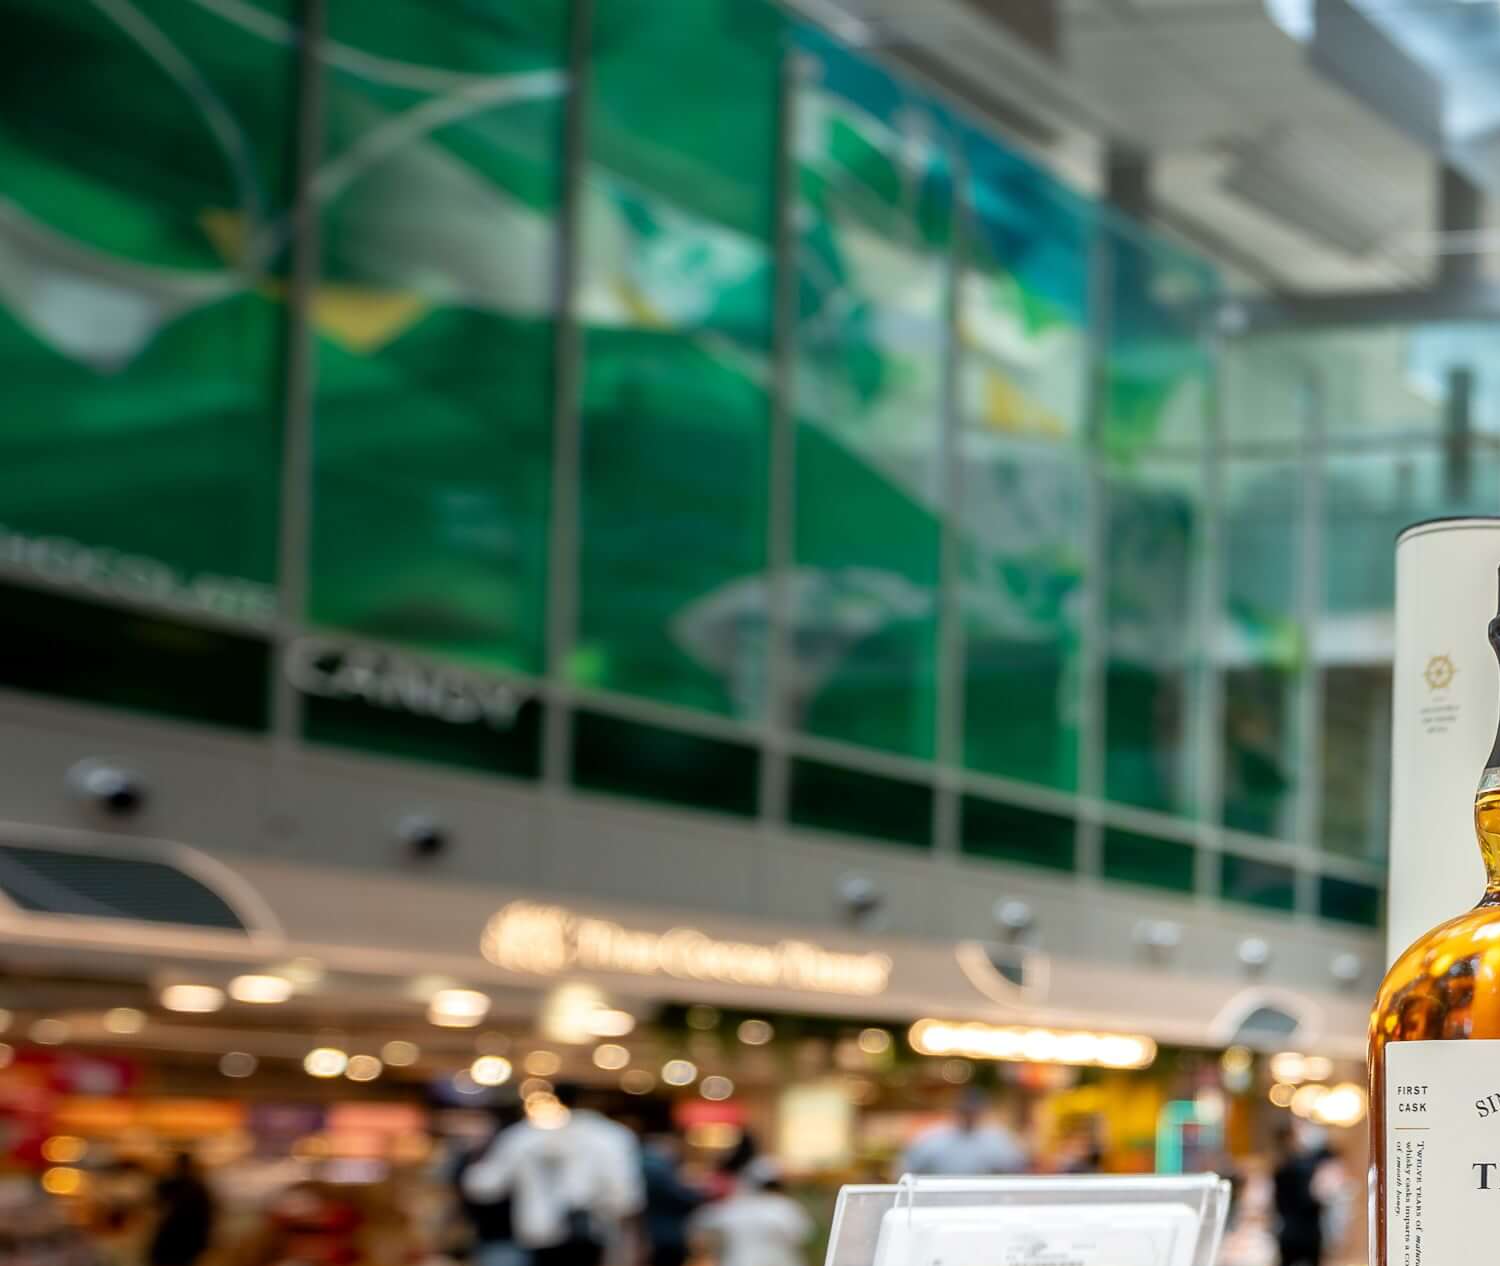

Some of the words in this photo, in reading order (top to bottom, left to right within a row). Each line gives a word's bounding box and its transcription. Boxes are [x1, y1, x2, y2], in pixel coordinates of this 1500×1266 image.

[1397, 1085, 1428, 1096] FIRST
[1398, 1102, 1427, 1113] CASK
[1404, 1141, 1414, 1174] whisky
[1404, 1178, 1414, 1202] casks
[1403, 1206, 1413, 1241] imparts
